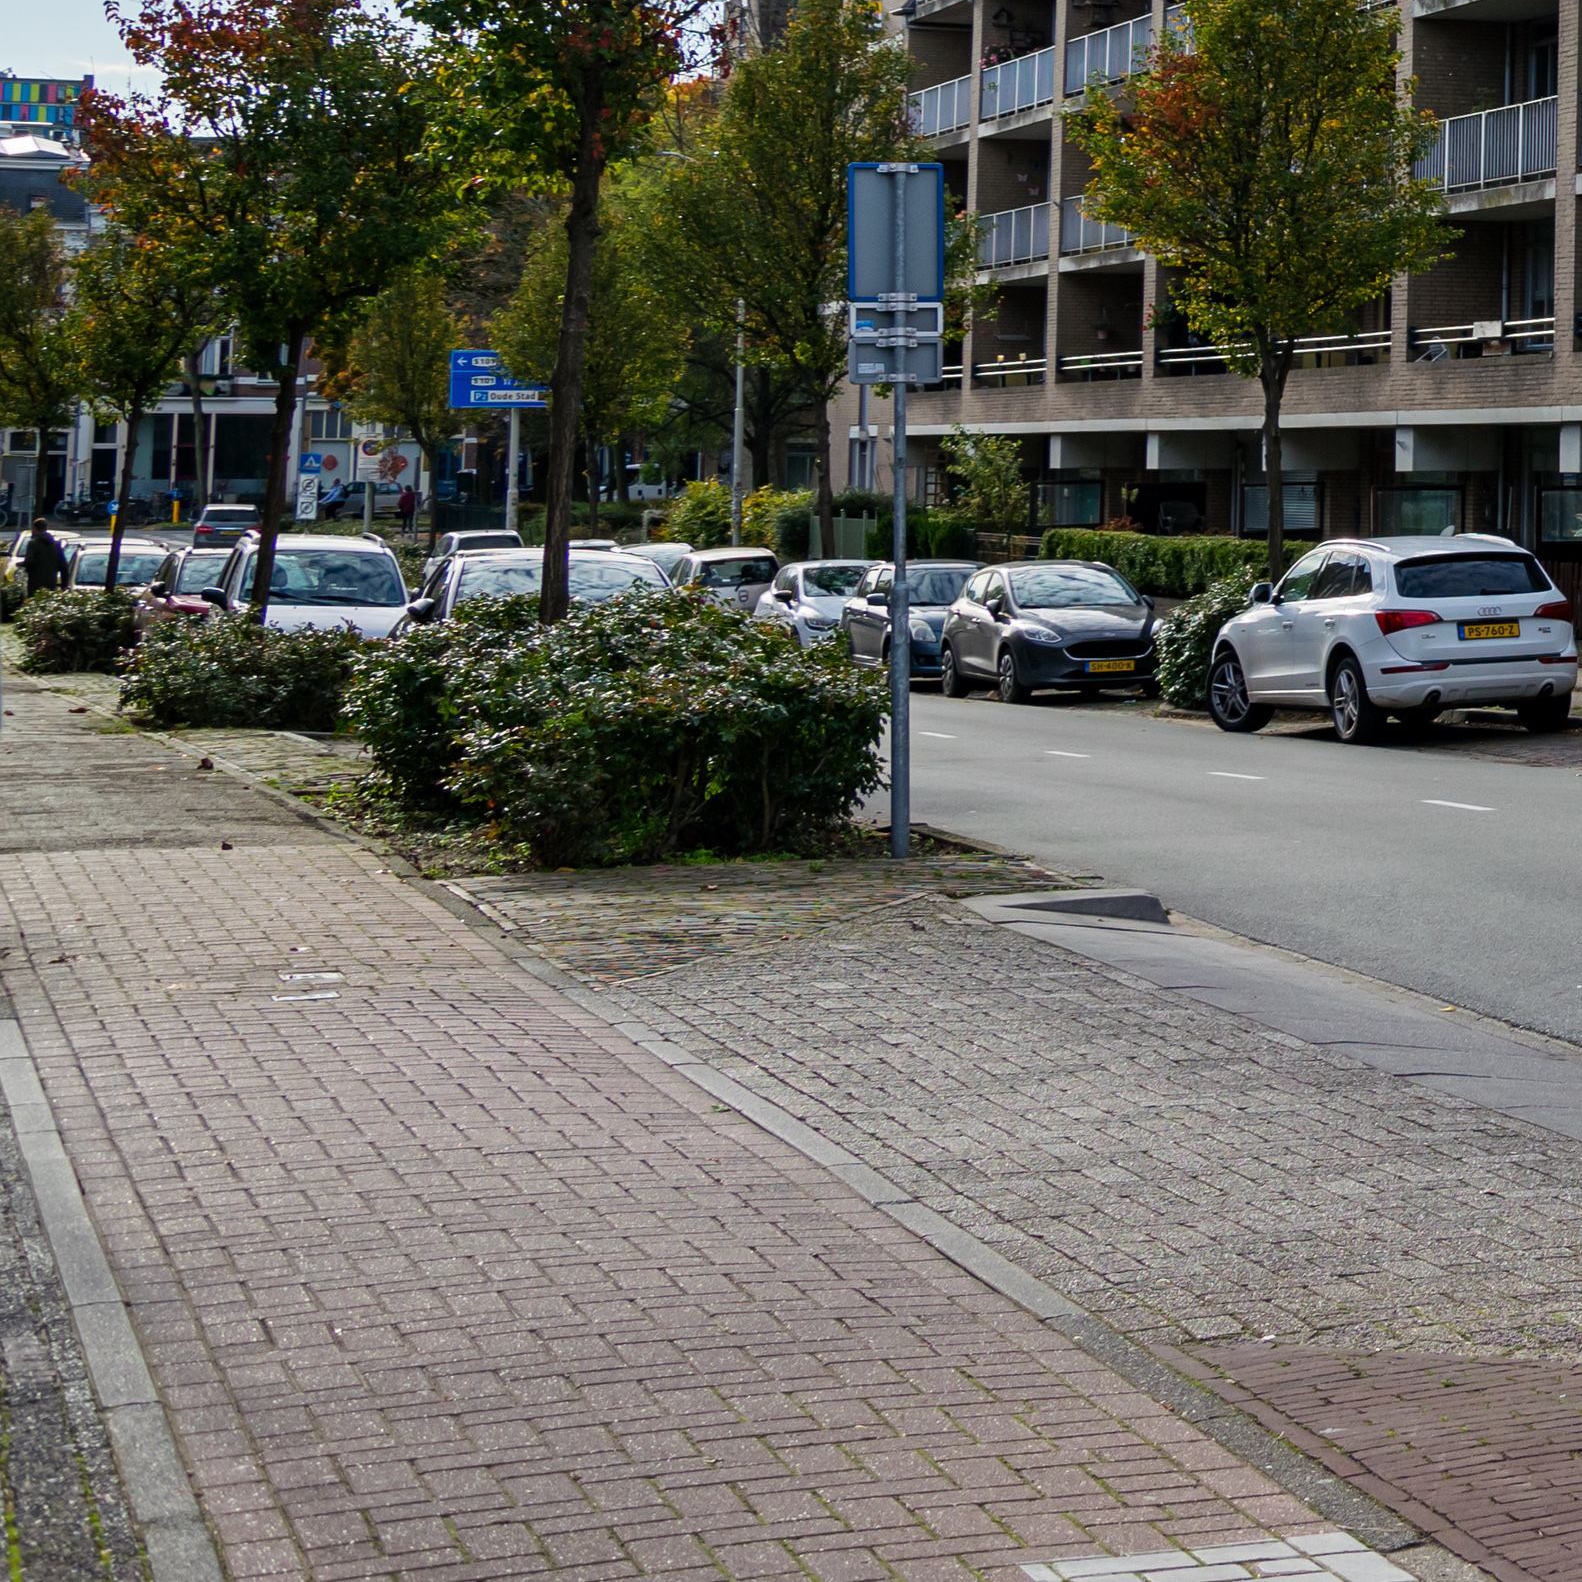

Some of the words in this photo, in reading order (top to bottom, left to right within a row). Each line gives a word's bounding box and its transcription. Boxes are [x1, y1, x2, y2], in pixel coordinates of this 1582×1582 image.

[490, 392, 514, 400] Oude
[516, 392, 536, 400] Stad
[1468, 624, 1515, 637] PS-760-Z
